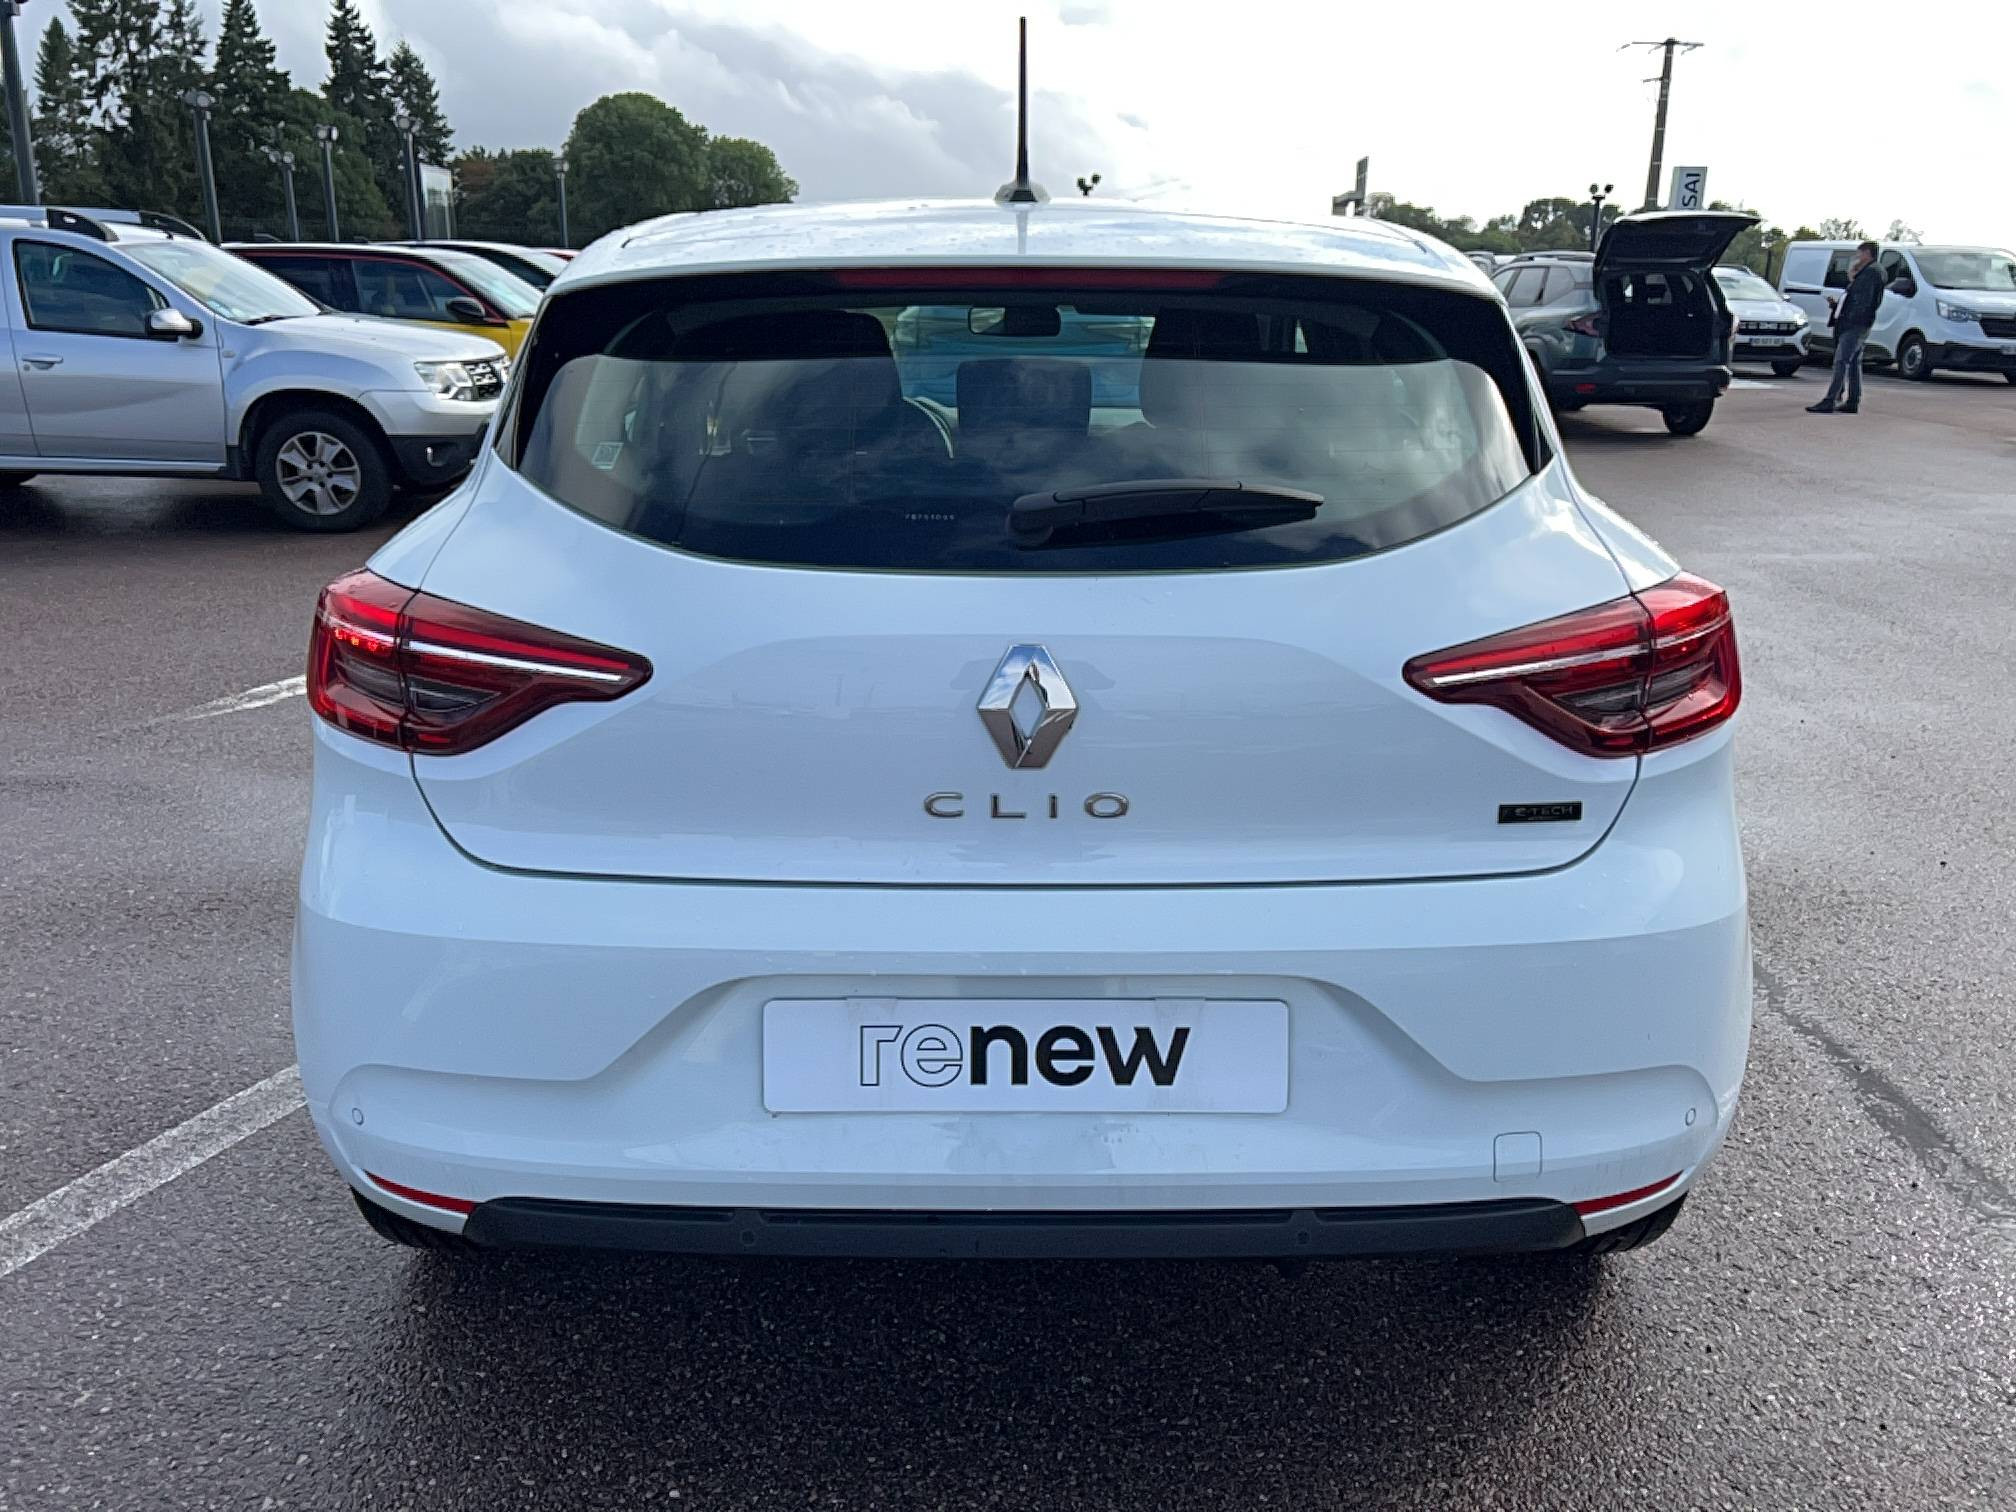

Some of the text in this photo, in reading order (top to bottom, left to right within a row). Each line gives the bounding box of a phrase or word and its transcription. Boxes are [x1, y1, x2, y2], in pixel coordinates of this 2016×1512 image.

[1681, 173, 1701, 209] SAI
[923, 792, 1131, 820] CLIO
[859, 1023, 1191, 1088] renew
